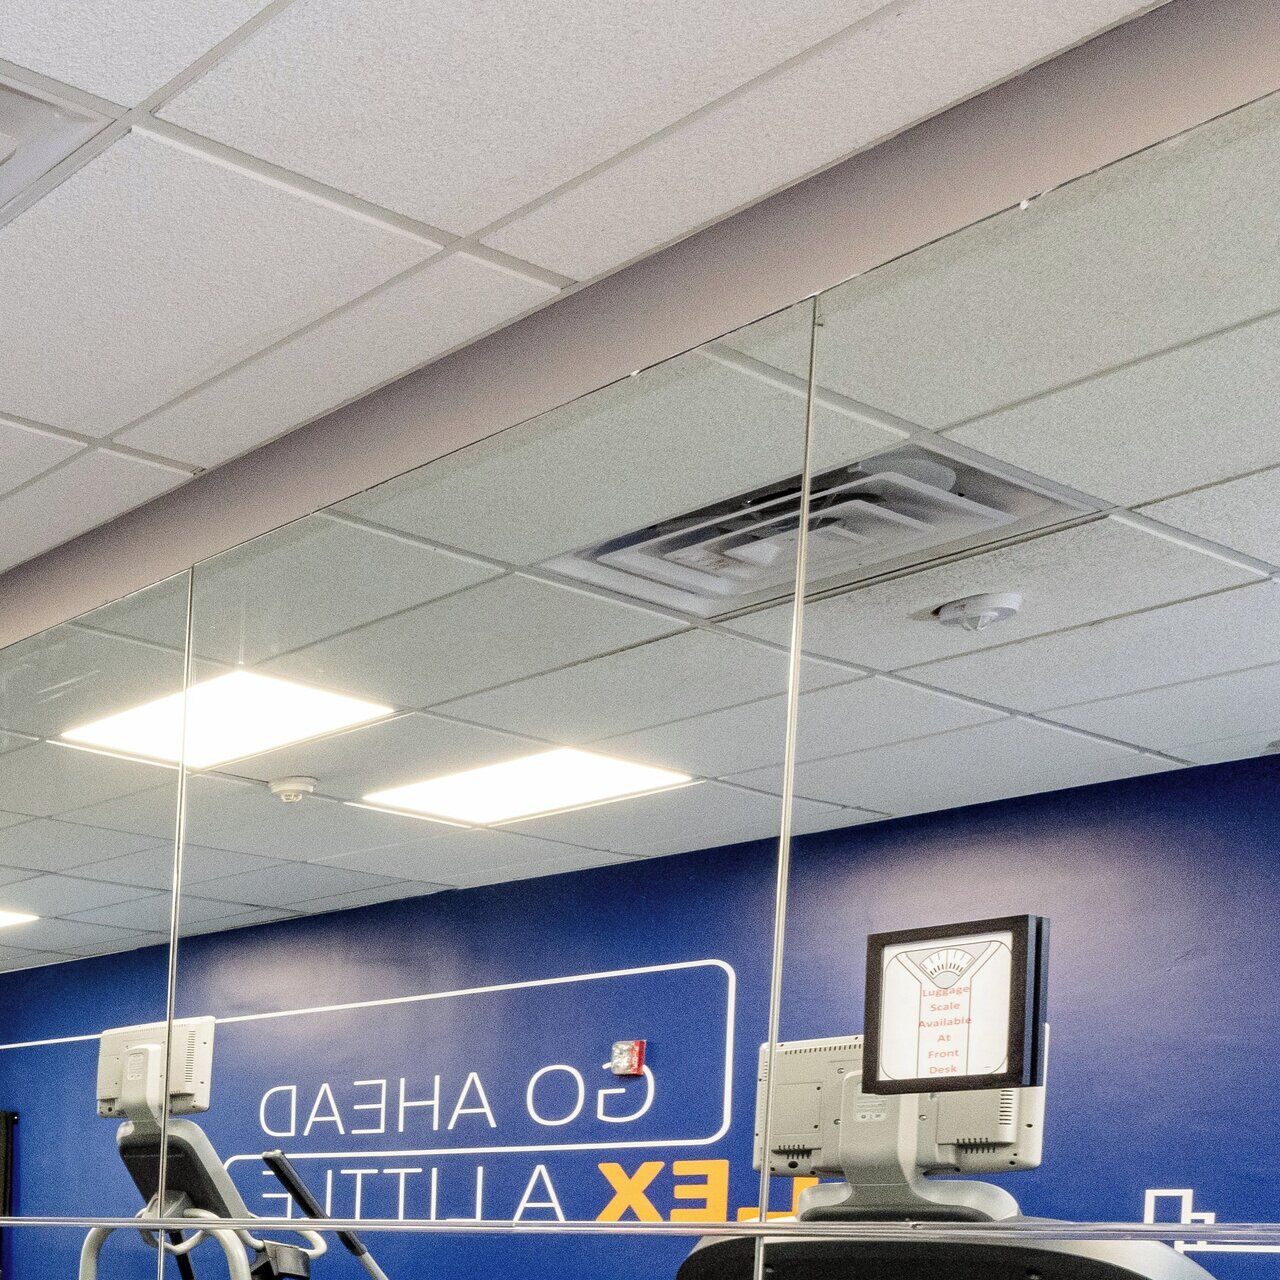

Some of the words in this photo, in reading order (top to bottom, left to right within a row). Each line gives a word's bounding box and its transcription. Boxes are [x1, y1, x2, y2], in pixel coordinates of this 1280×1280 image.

[922, 986, 969, 997] Luggage
[931, 1002, 960, 1011] Scale
[919, 1017, 971, 1027] Available
[928, 1050, 959, 1058] Front
[930, 1065, 957, 1074] Desk
